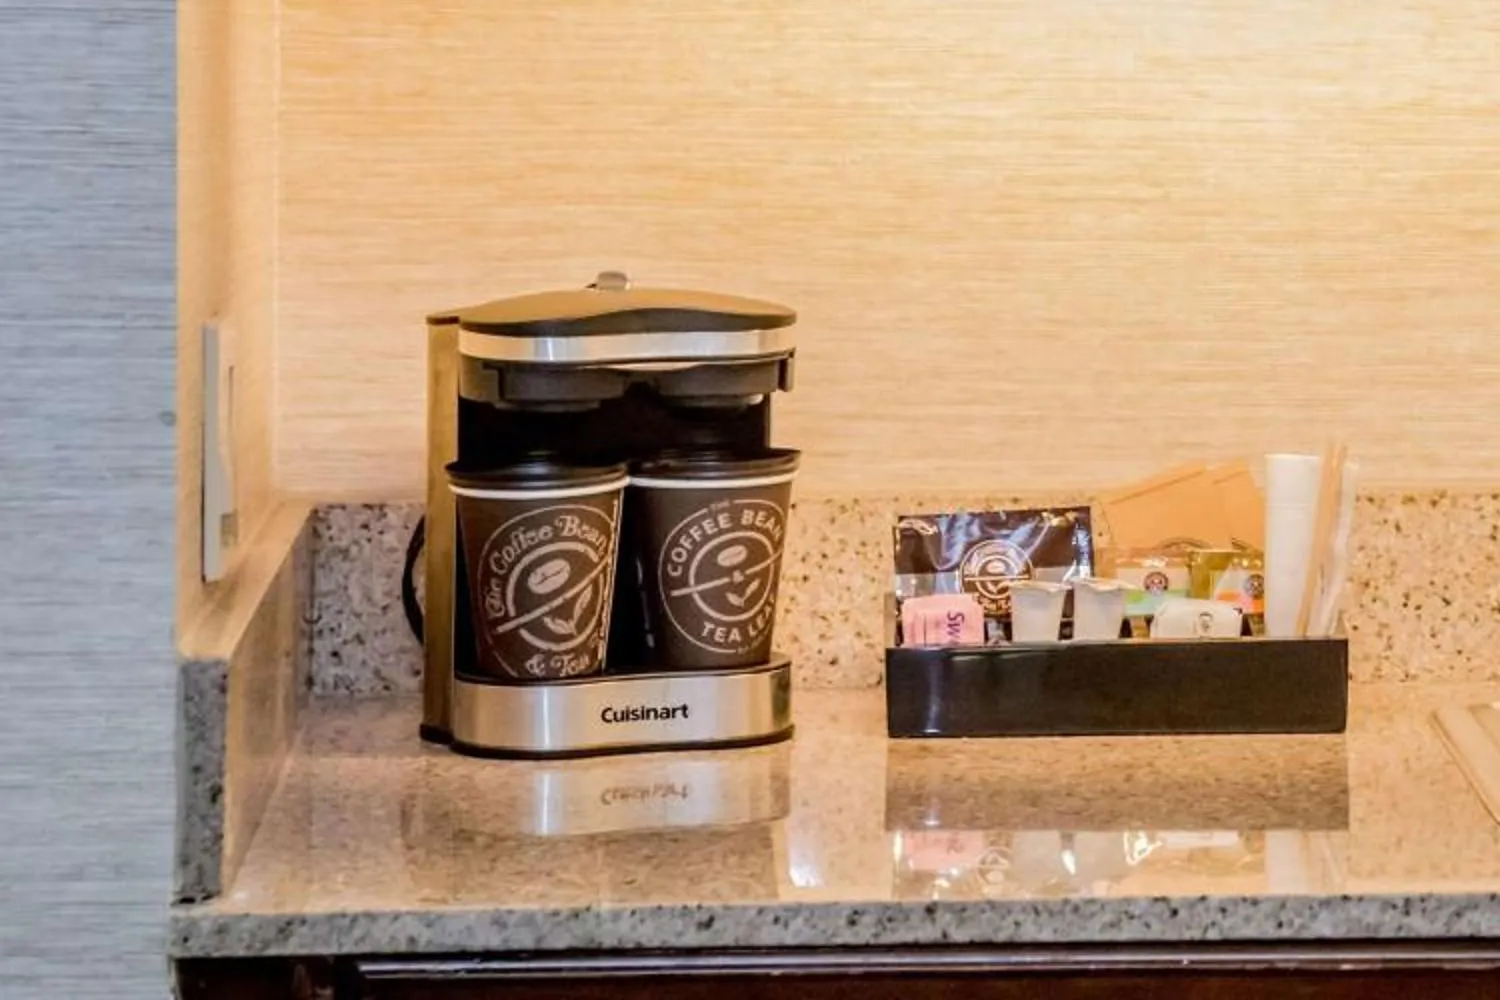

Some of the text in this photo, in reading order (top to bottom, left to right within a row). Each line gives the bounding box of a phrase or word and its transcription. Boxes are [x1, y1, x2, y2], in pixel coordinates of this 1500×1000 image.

[489, 525, 554, 575] Coffee
[554, 514, 608, 557] Bean
[667, 512, 733, 577] COFFEE
[701, 620, 742, 643] TEA
[600, 703, 689, 724] Cuisinart
